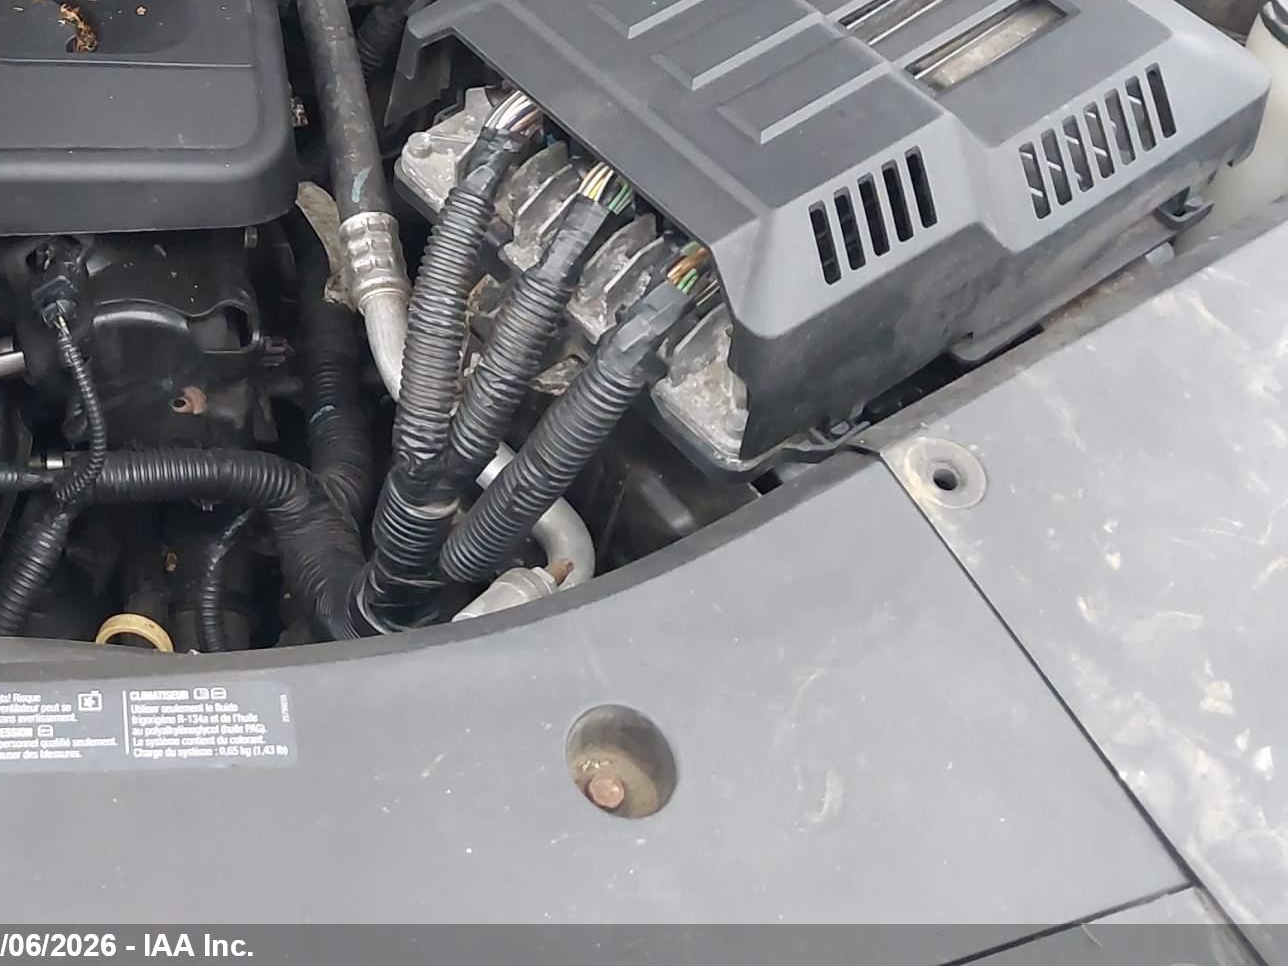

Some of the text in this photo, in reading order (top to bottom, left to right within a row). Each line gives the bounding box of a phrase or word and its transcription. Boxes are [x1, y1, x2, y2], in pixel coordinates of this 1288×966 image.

[13, 693, 41, 703] Risque
[130, 690, 188, 700] CLIMATISEUR
[41, 703, 59, 713] peut
[131, 703, 238, 713] Utiliser seulement le fluide
[17, 713, 78, 723] avertissement.
[178, 714, 208, 723] R-134a
[210, 714, 219, 723] et
[221, 714, 231, 722] de
[233, 713, 258, 722] l'huile
[221, 725, 243, 734] (huile
[133, 738, 143, 746] Le
[182, 736, 215, 745] contient
[217, 736, 228, 744] du
[23, 750, 38, 759] des
[134, 749, 163, 758] Charge
[165, 748, 176, 756] du
[240, 746, 251, 756] kg
